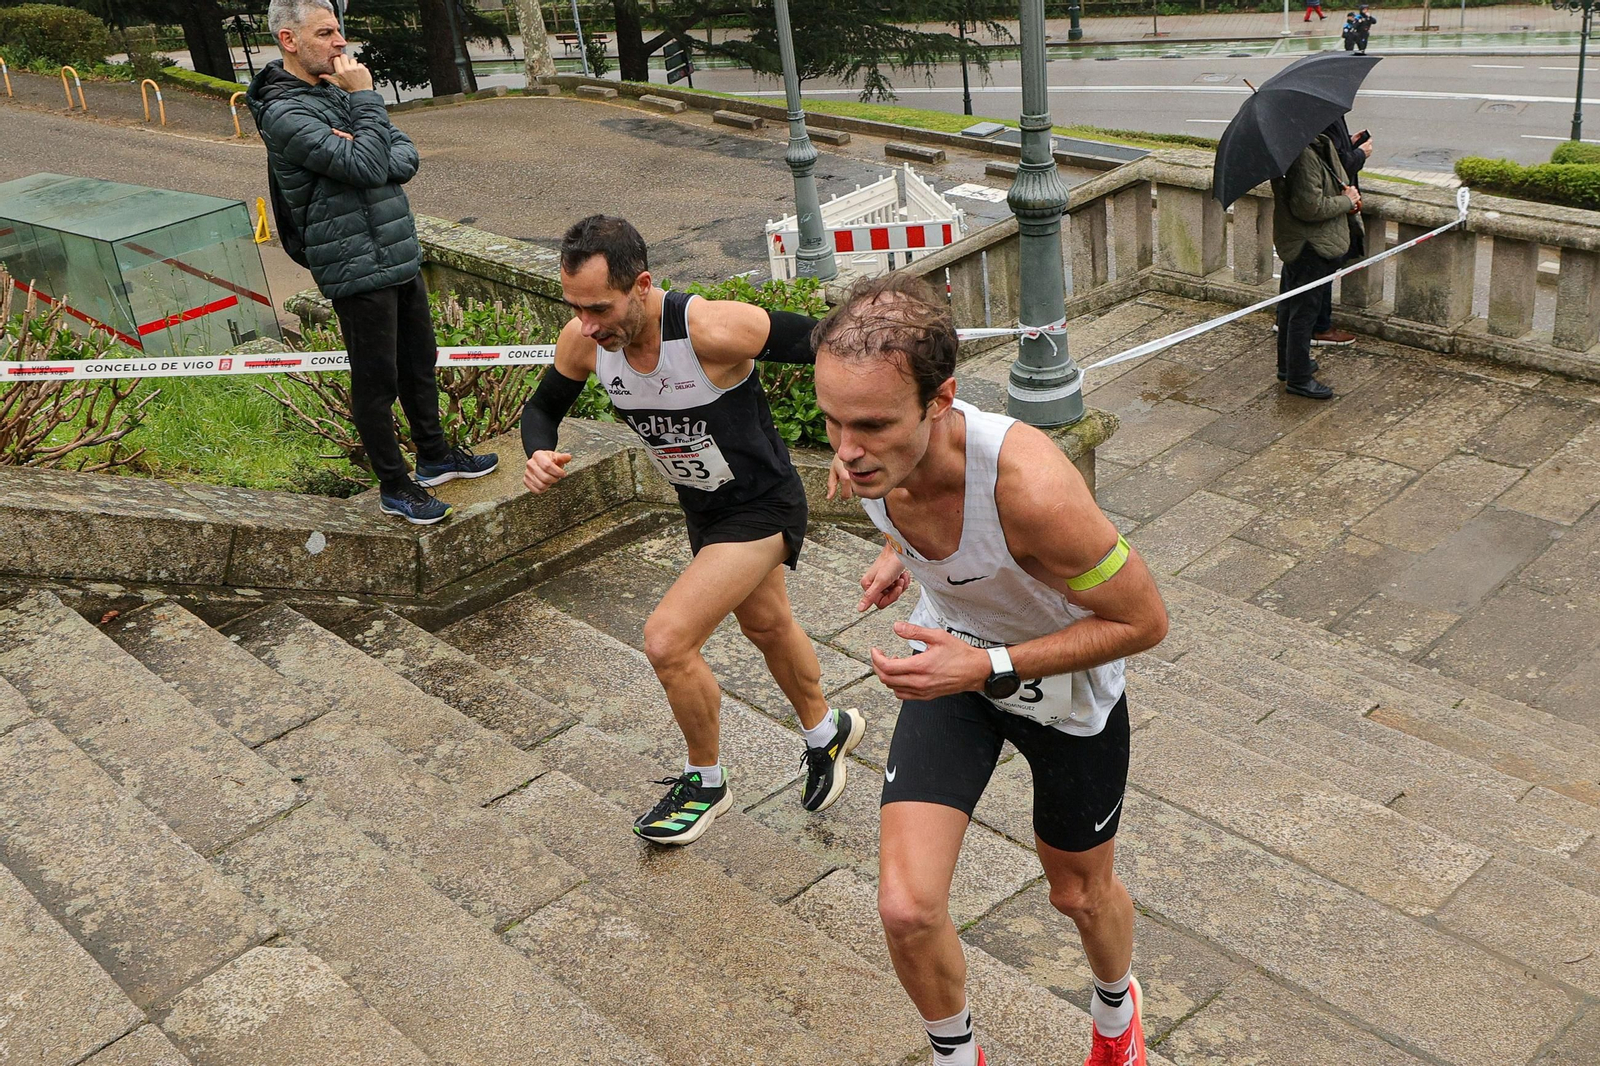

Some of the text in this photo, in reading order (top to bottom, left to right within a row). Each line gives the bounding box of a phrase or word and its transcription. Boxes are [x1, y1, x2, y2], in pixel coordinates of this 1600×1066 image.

[85, 360, 214, 373] CONCELLO DE VIGO
[674, 383, 696, 391] DELIKIA
